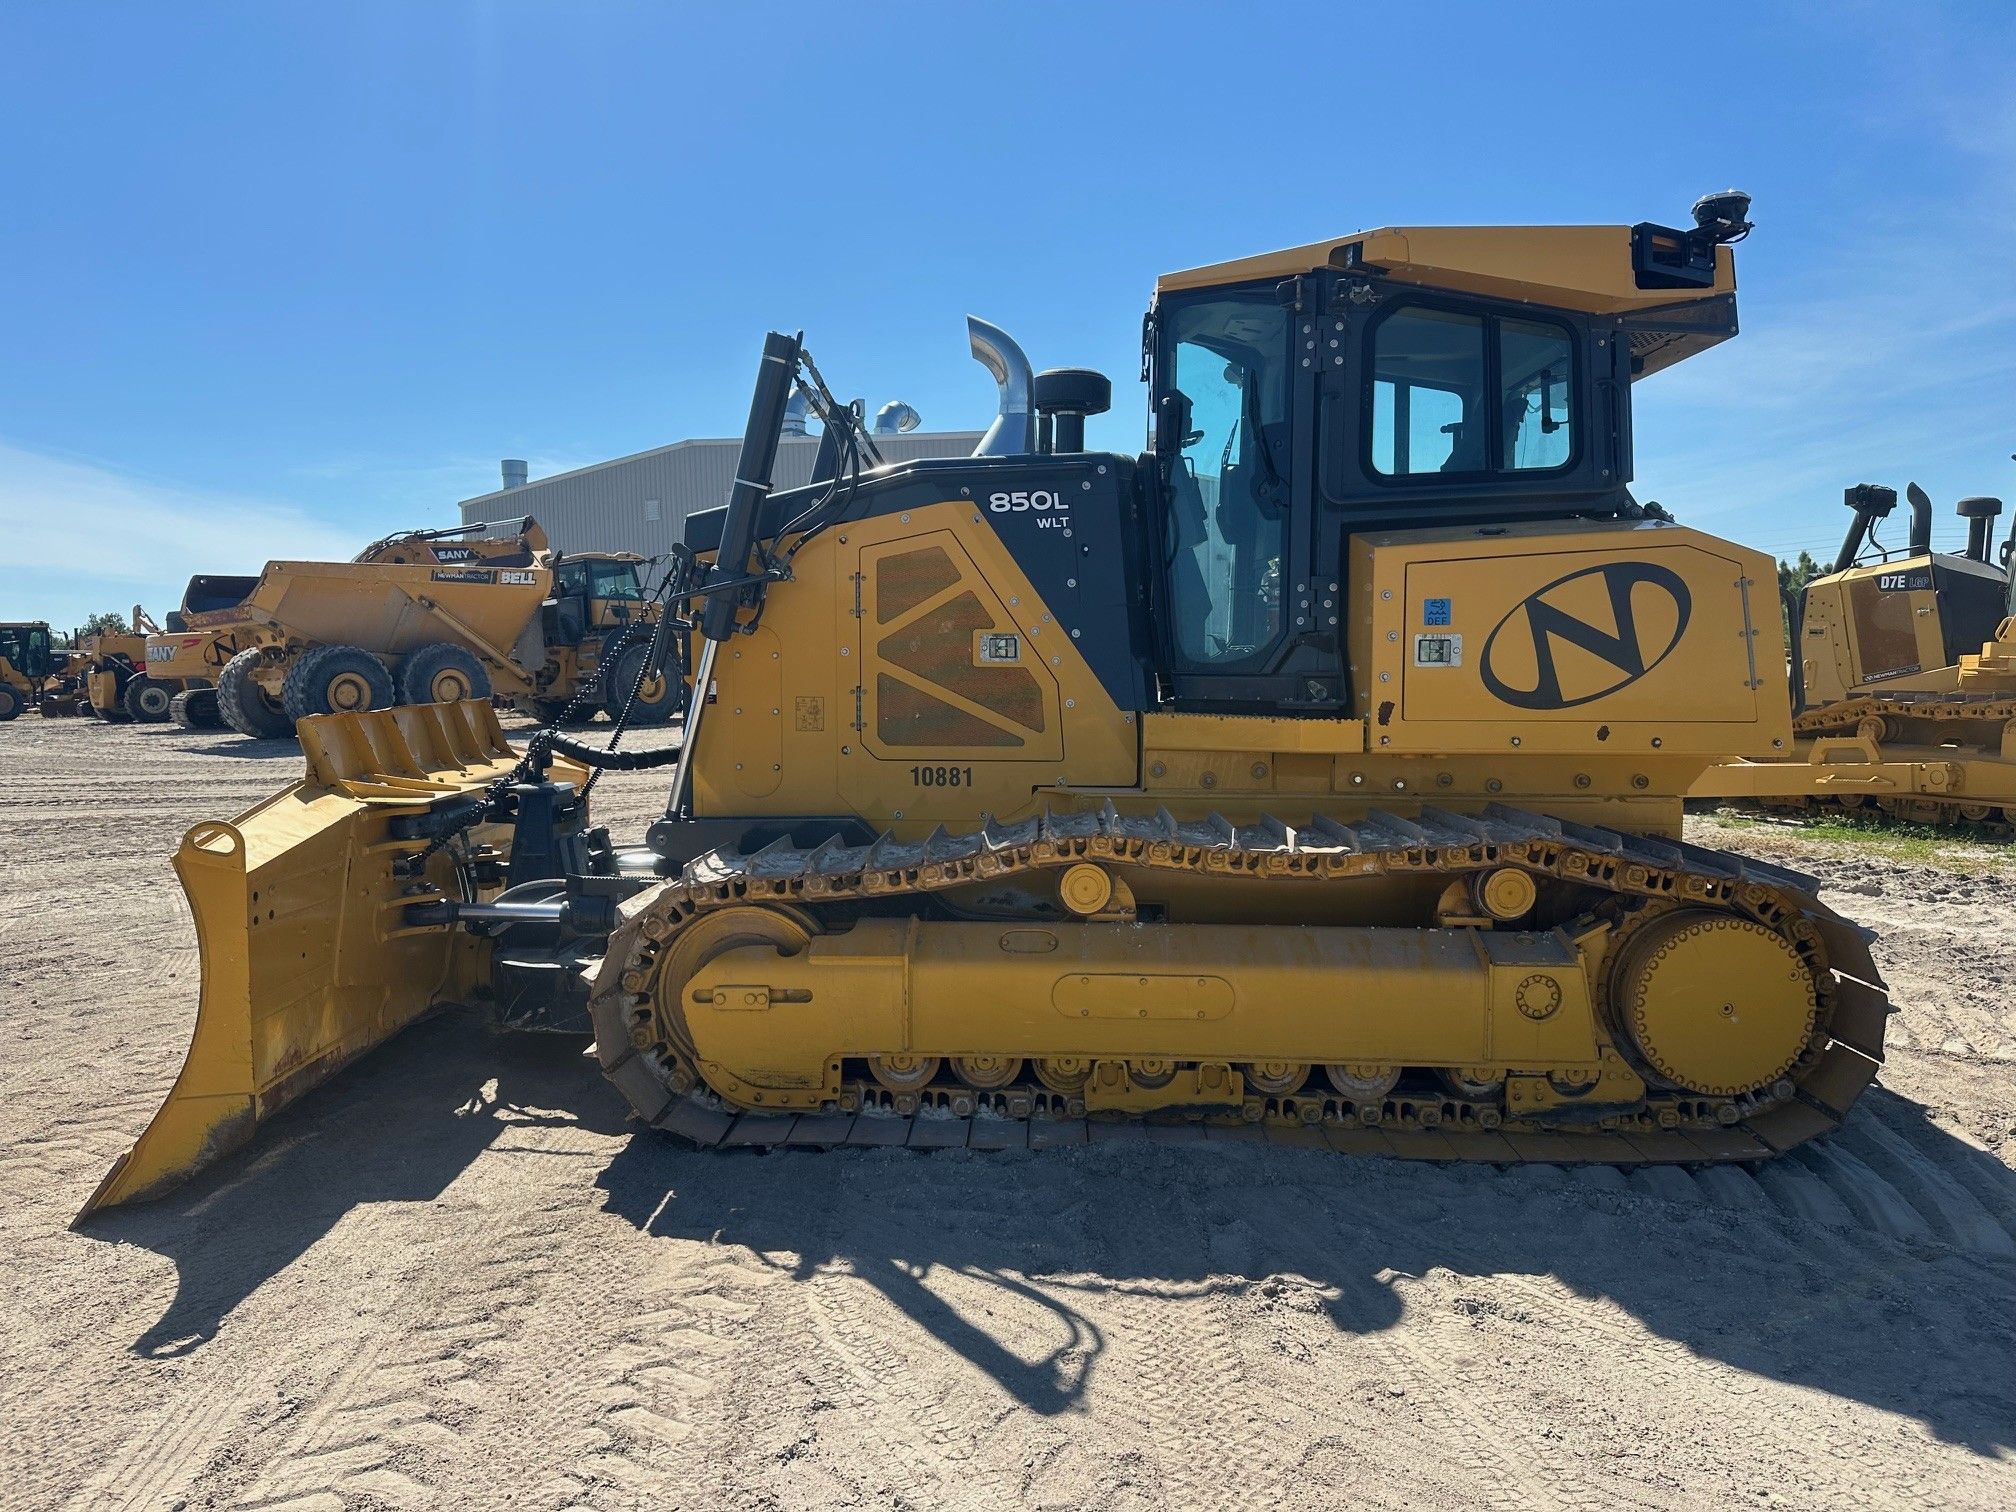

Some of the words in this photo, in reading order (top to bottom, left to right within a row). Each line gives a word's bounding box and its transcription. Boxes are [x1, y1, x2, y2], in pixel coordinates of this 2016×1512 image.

[989, 490, 1069, 512] 850L
[1036, 517, 1069, 528] WLT
[438, 550, 470, 560] SANY
[500, 571, 536, 584] BELL
[1880, 575, 1906, 589] D7E
[1427, 616, 1448, 626] DEF
[910, 766, 972, 787] 10881
